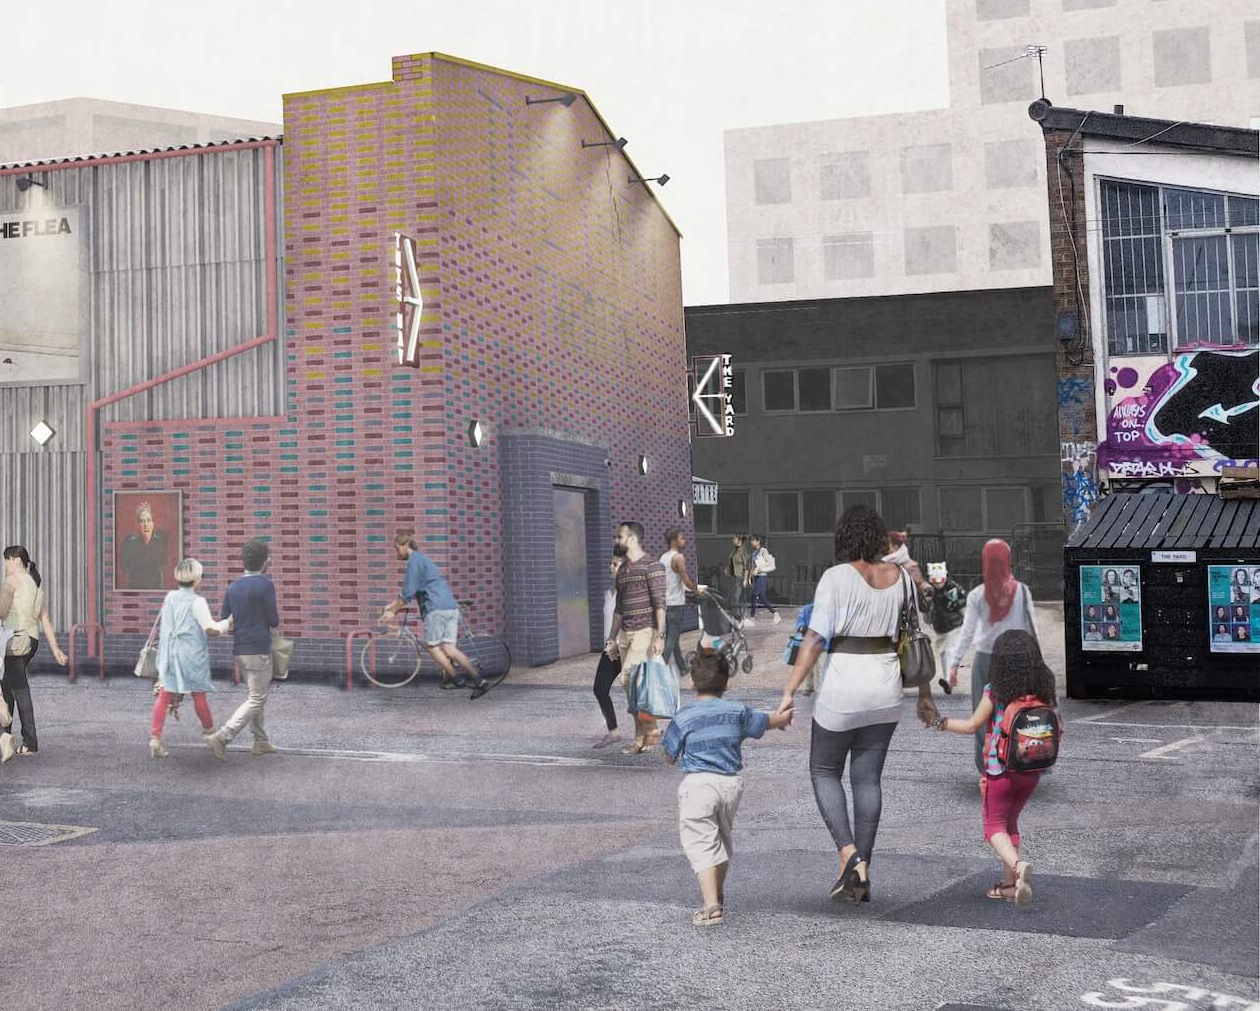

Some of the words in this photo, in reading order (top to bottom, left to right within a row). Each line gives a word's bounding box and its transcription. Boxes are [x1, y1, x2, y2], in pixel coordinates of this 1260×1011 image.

[23, 217, 72, 237] FLEA
[722, 354, 733, 387] THE
[724, 394, 735, 436] YARD
[1115, 430, 1141, 443] TOP
